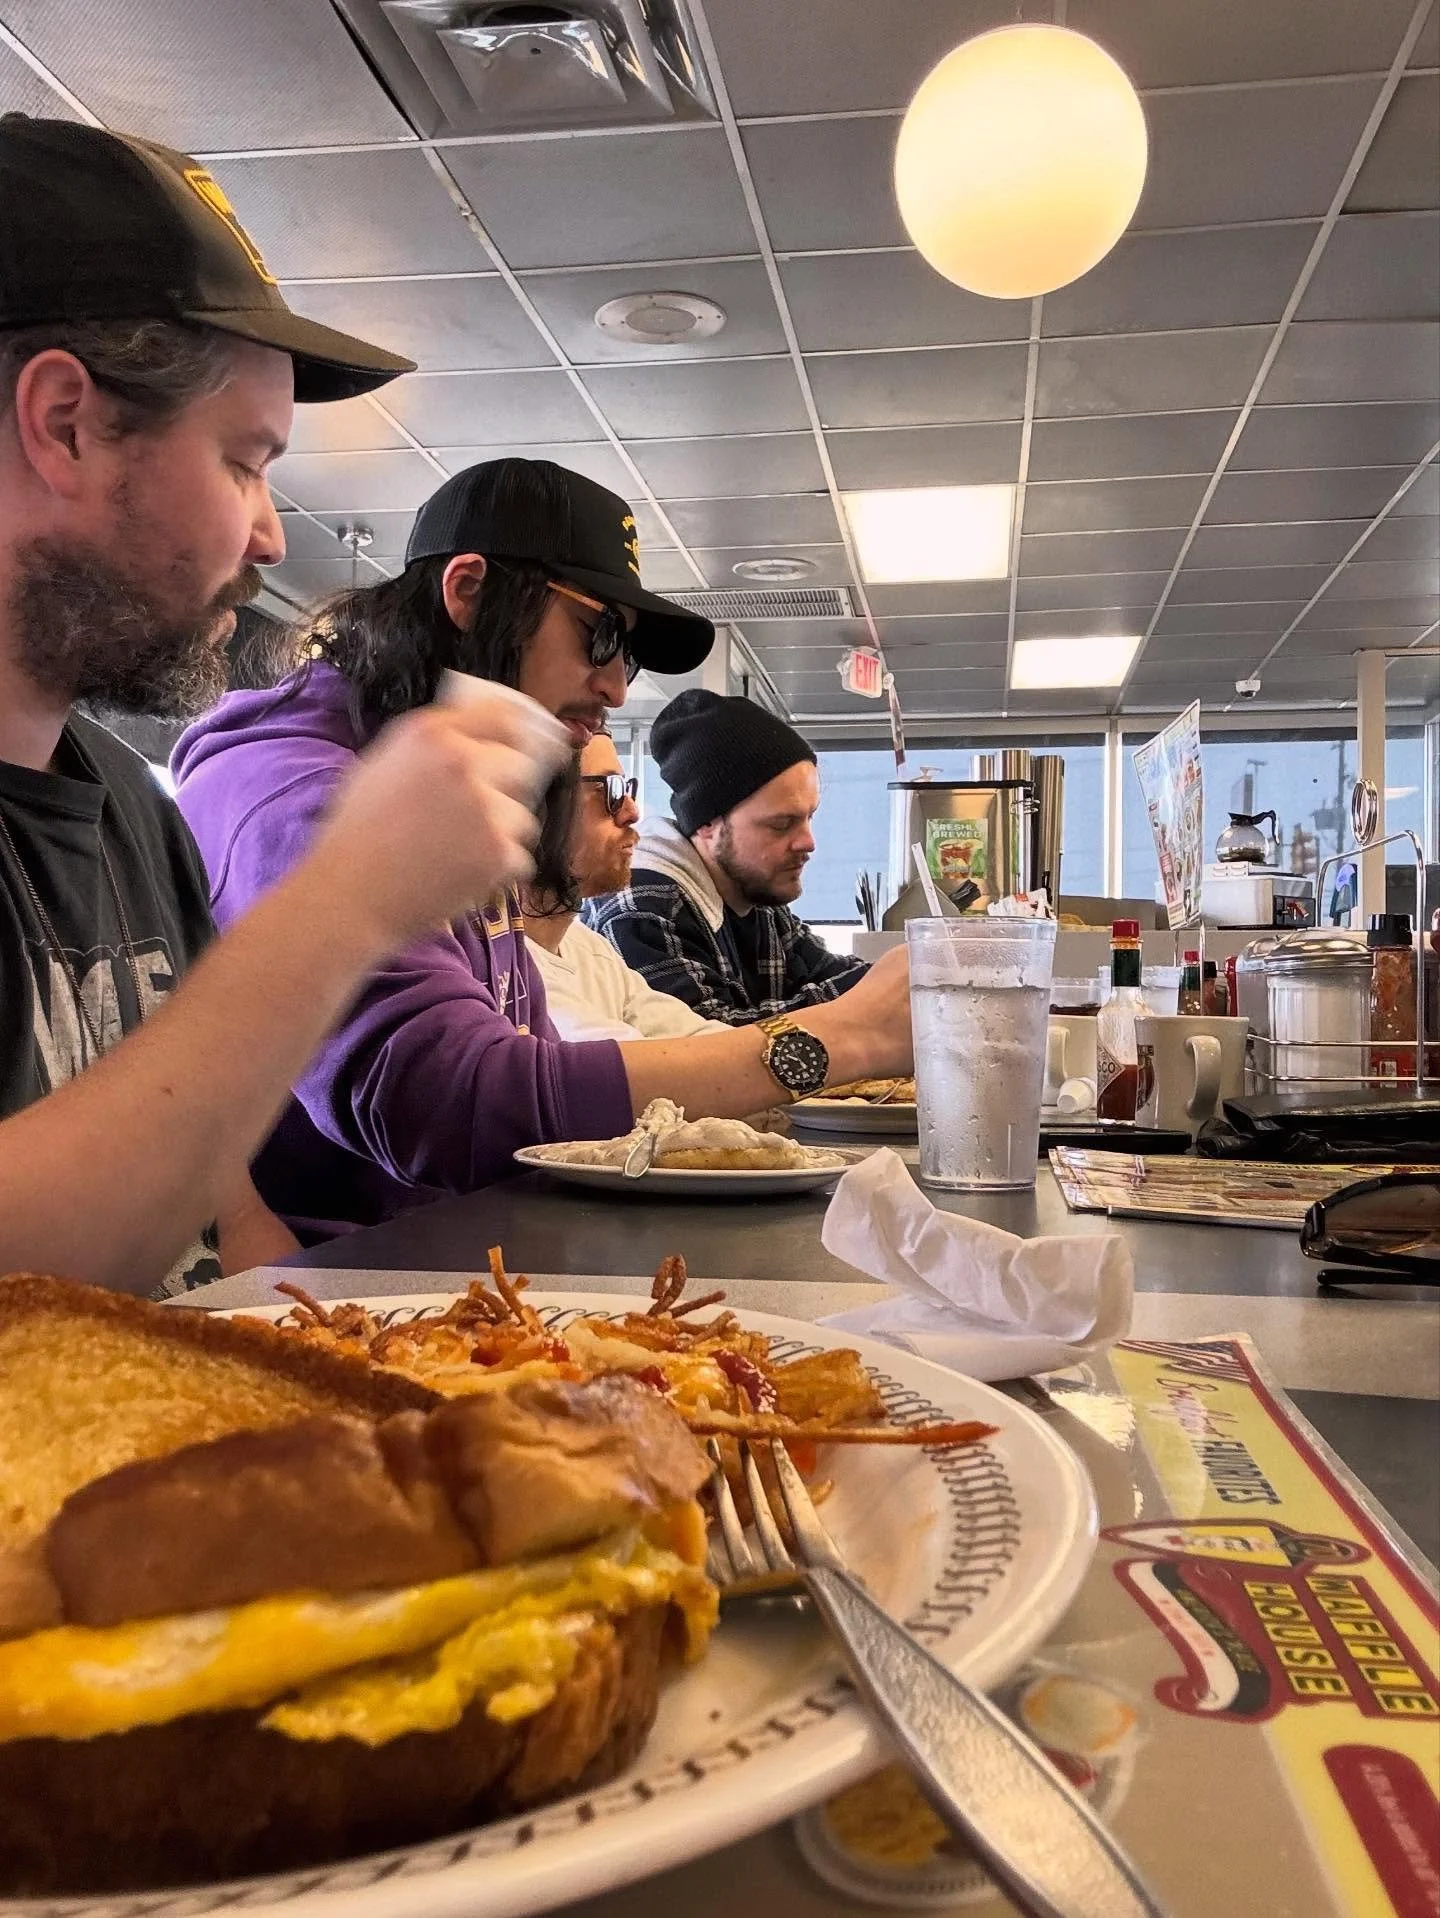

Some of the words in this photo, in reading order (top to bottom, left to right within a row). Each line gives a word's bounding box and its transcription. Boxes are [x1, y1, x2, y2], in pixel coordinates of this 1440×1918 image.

[855, 653, 879, 692] EXIT
[1190, 1440, 1283, 1505] FAVORITES
[1250, 1582, 1345, 1693] HOUSE
[1308, 1577, 1436, 1712] WAFFLE
